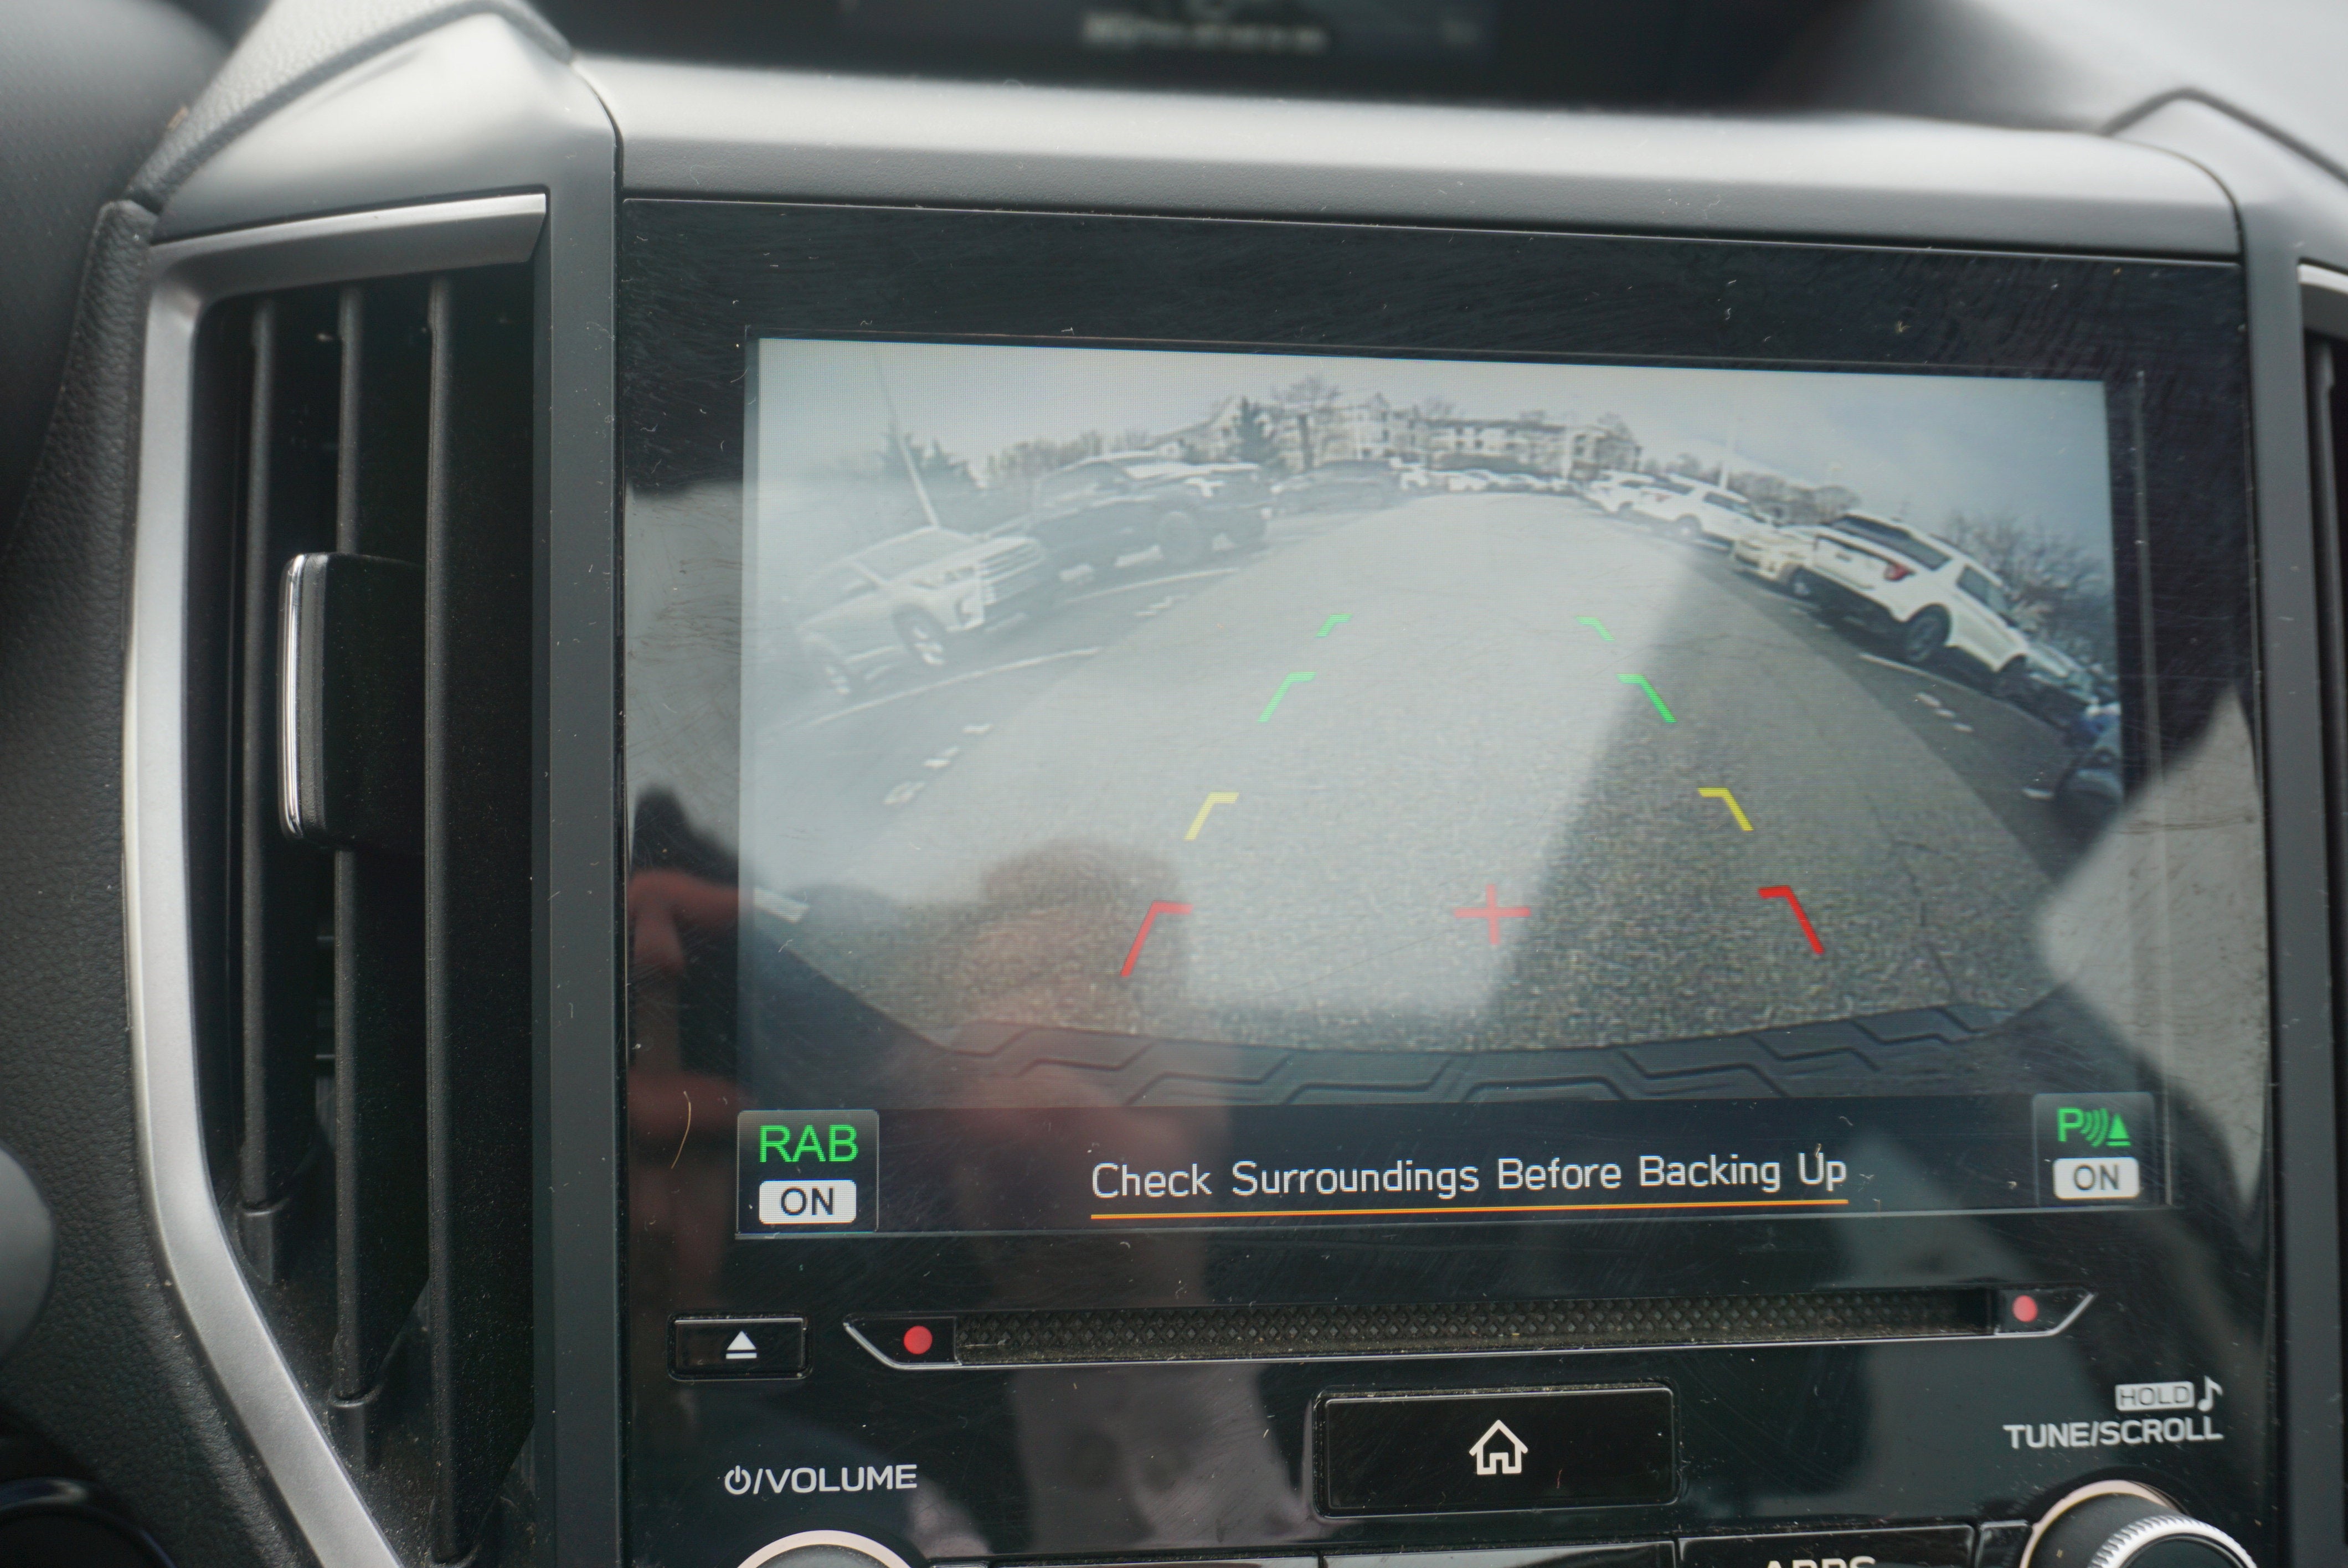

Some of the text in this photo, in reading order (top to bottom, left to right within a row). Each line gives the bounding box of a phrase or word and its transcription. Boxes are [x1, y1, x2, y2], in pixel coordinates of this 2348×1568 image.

[759, 1124, 859, 1163] RAB
[1091, 1152, 1847, 1199] Check Surroundings Before Backing Up
[2073, 1164, 2120, 1192] ON
[780, 1186, 835, 1216] ON
[2119, 1385, 2191, 1406] HOLD
[2002, 1415, 2225, 1450] TUNE/SCROLL
